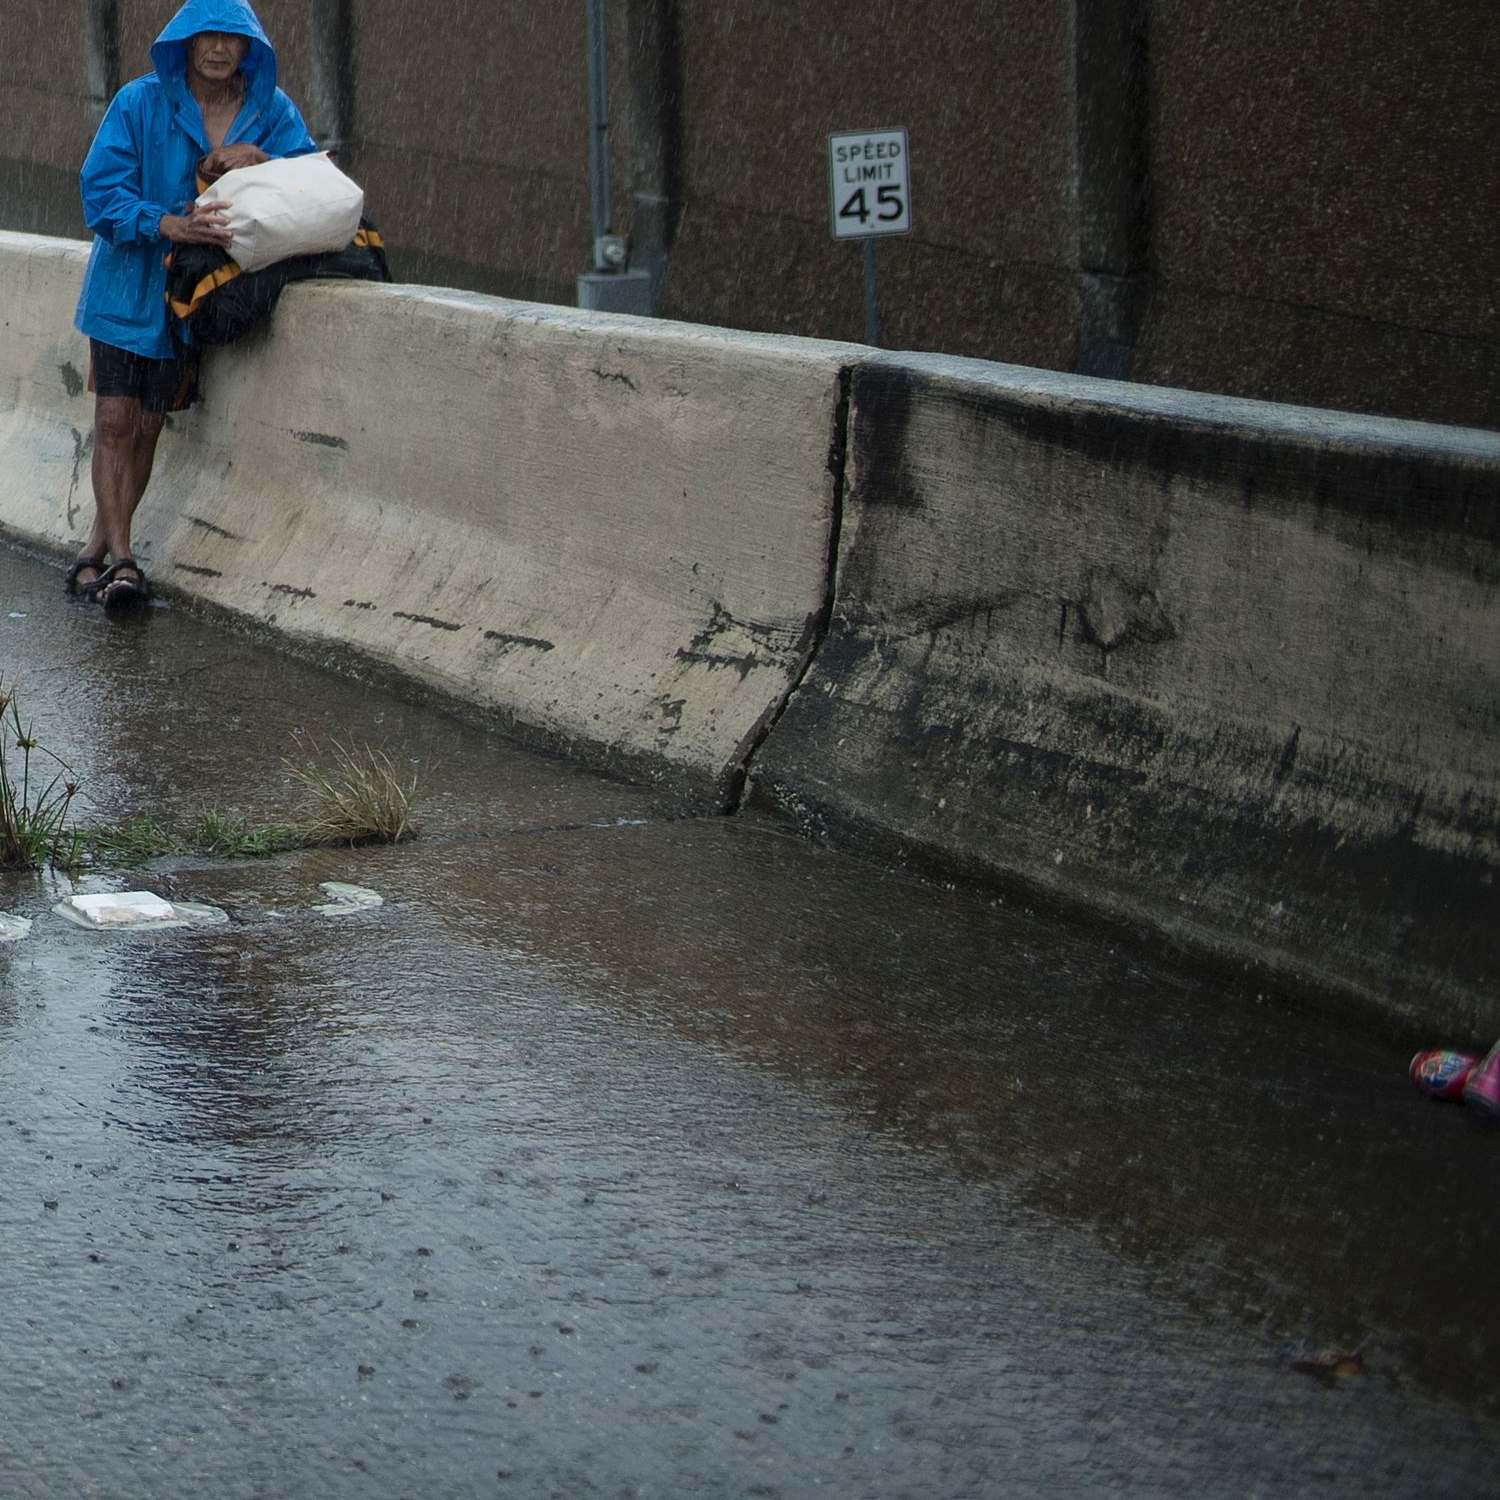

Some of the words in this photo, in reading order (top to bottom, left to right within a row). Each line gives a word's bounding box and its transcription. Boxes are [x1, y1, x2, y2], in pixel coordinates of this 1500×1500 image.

[836, 140, 901, 162] SPEED
[844, 162, 894, 183] LIMIT
[839, 183, 904, 224] 45
